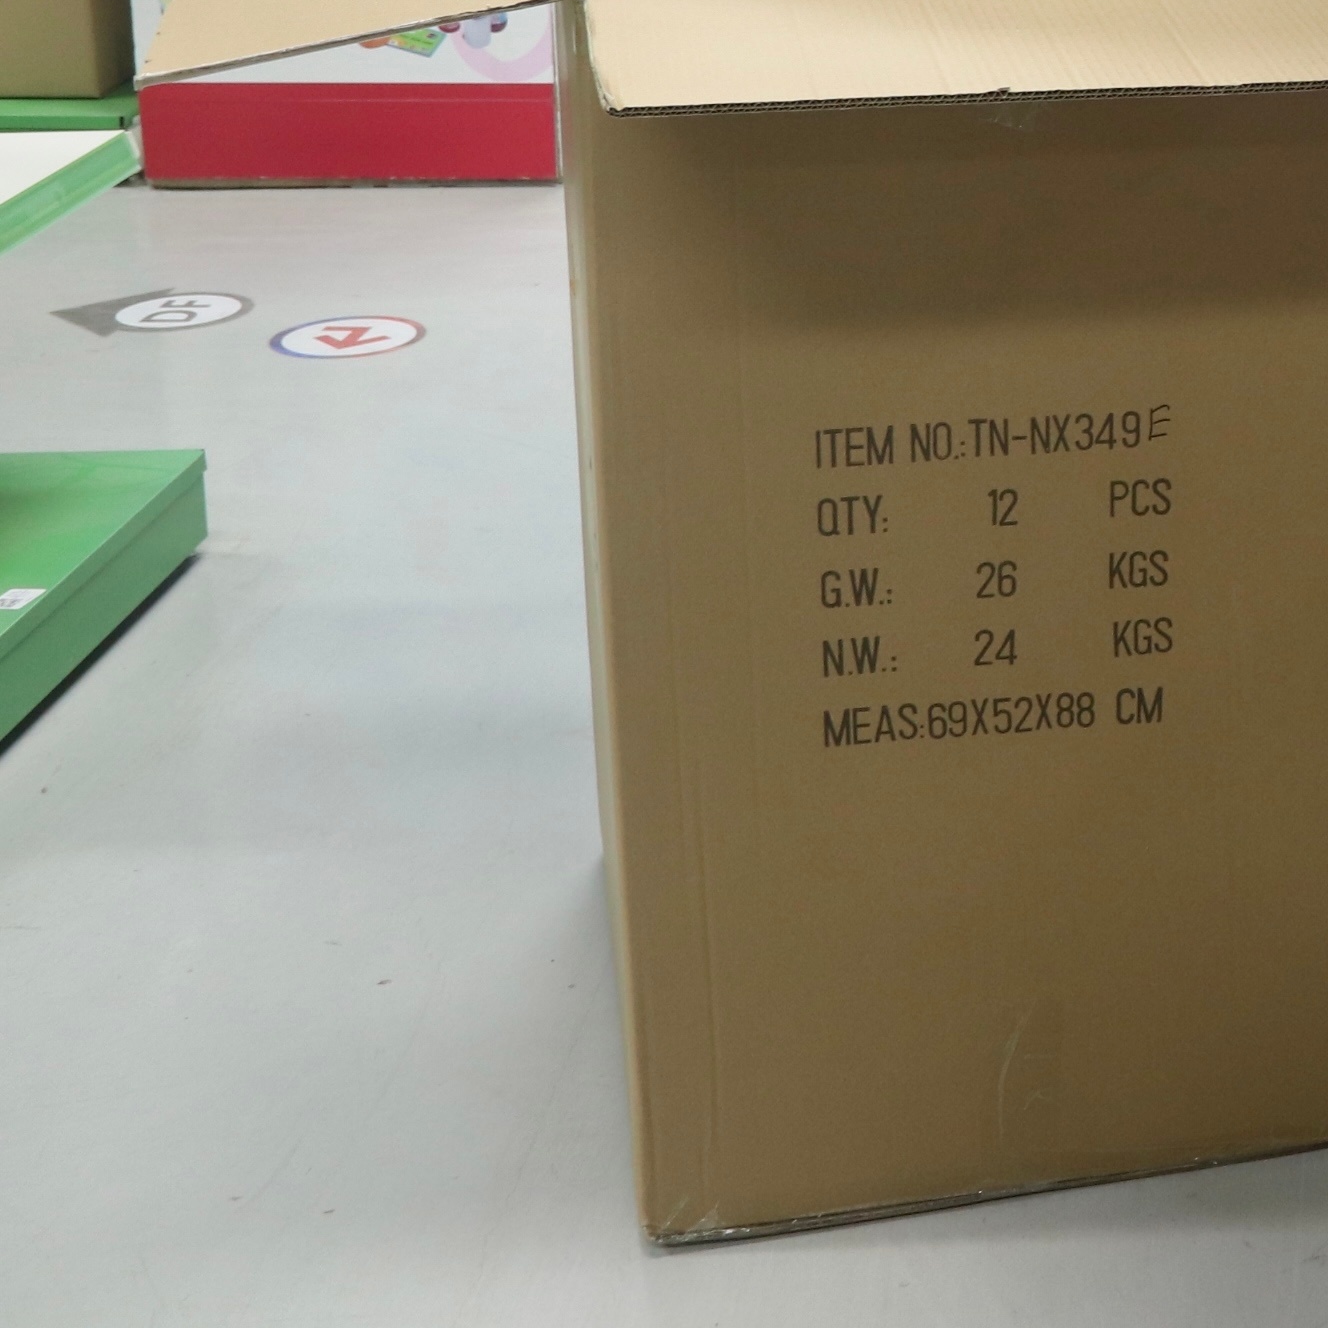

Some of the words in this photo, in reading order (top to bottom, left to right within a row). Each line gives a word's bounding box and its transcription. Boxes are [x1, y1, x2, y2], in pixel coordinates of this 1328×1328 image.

[815, 425, 894, 469] ITEM
[817, 495, 889, 536] QTY:
[987, 488, 1018, 526] 12
[1109, 478, 1172, 517] PCS
[820, 568, 893, 608] G.W.:
[976, 561, 1017, 598] 26
[1108, 550, 1169, 589] KGS
[822, 636, 898, 677] N.W.:
[973, 629, 1017, 666] 24
[1113, 618, 1173, 657] KGS
[1115, 687, 1164, 725] CM
